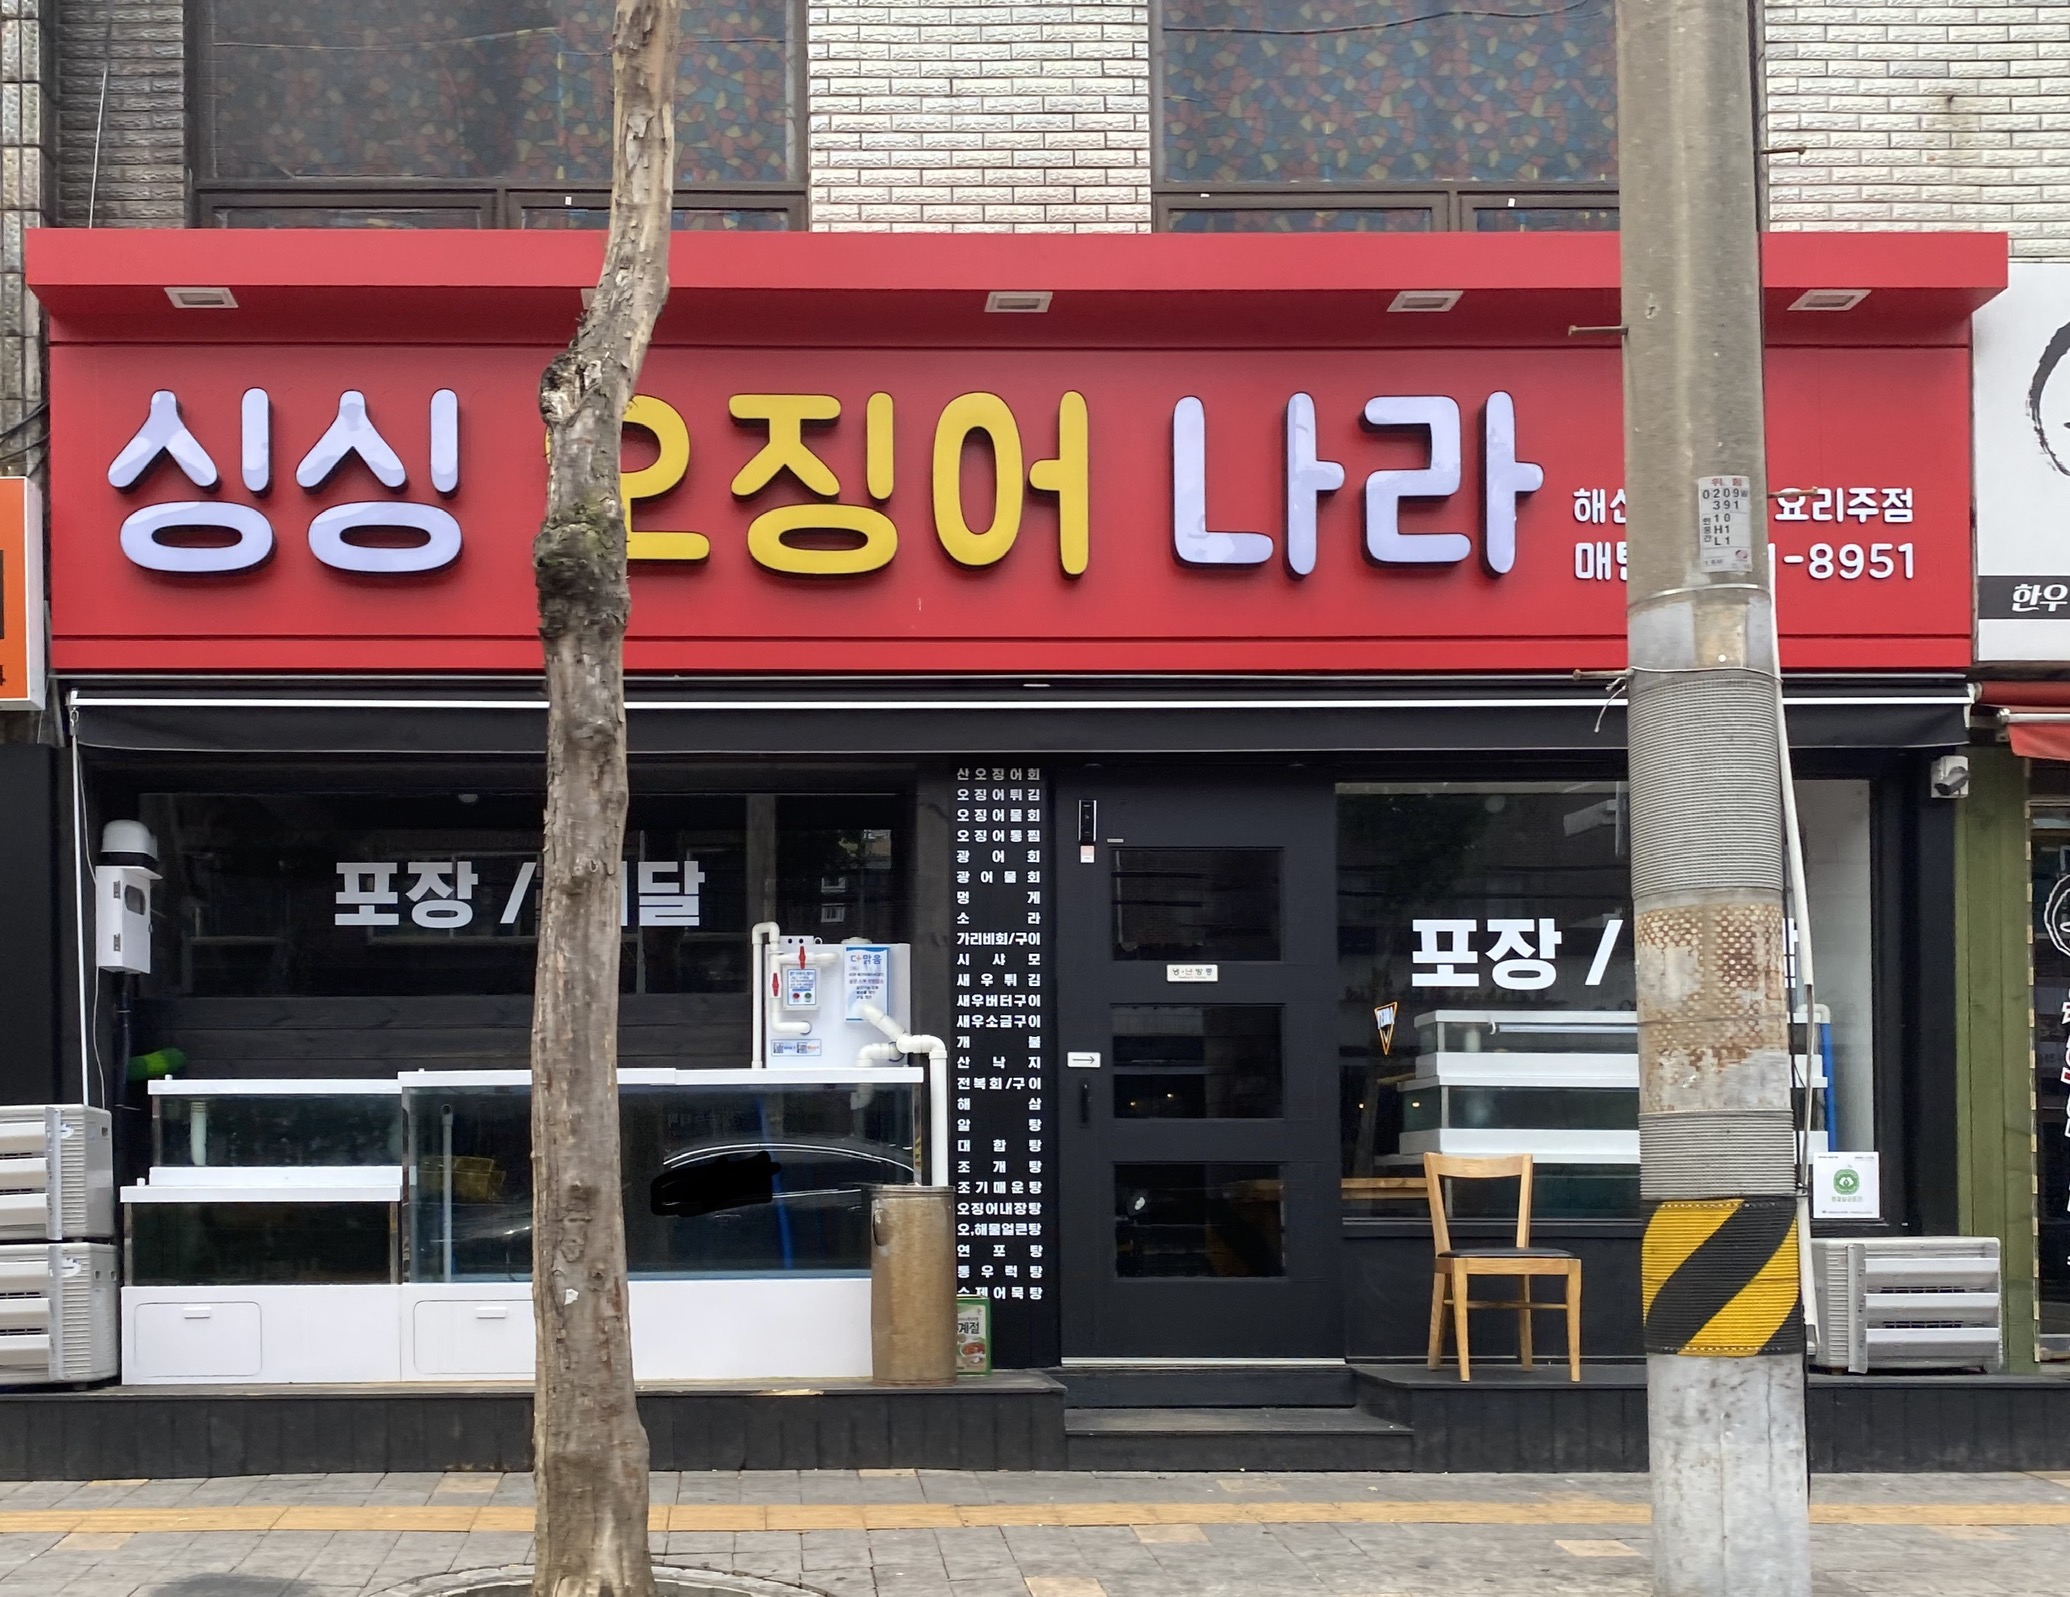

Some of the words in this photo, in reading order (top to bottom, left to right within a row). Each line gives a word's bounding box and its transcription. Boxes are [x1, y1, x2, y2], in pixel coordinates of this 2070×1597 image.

[107, 387, 463, 575] 싱싱
[545, 390, 1090, 577] 오징어
[1172, 390, 1546, 577] 나라
[1775, 487, 1914, 523] 요리주점
[2011, 583, 2069, 612] 한우
[334, 861, 479, 928] 포장
[1411, 918, 1562, 990] 포장
